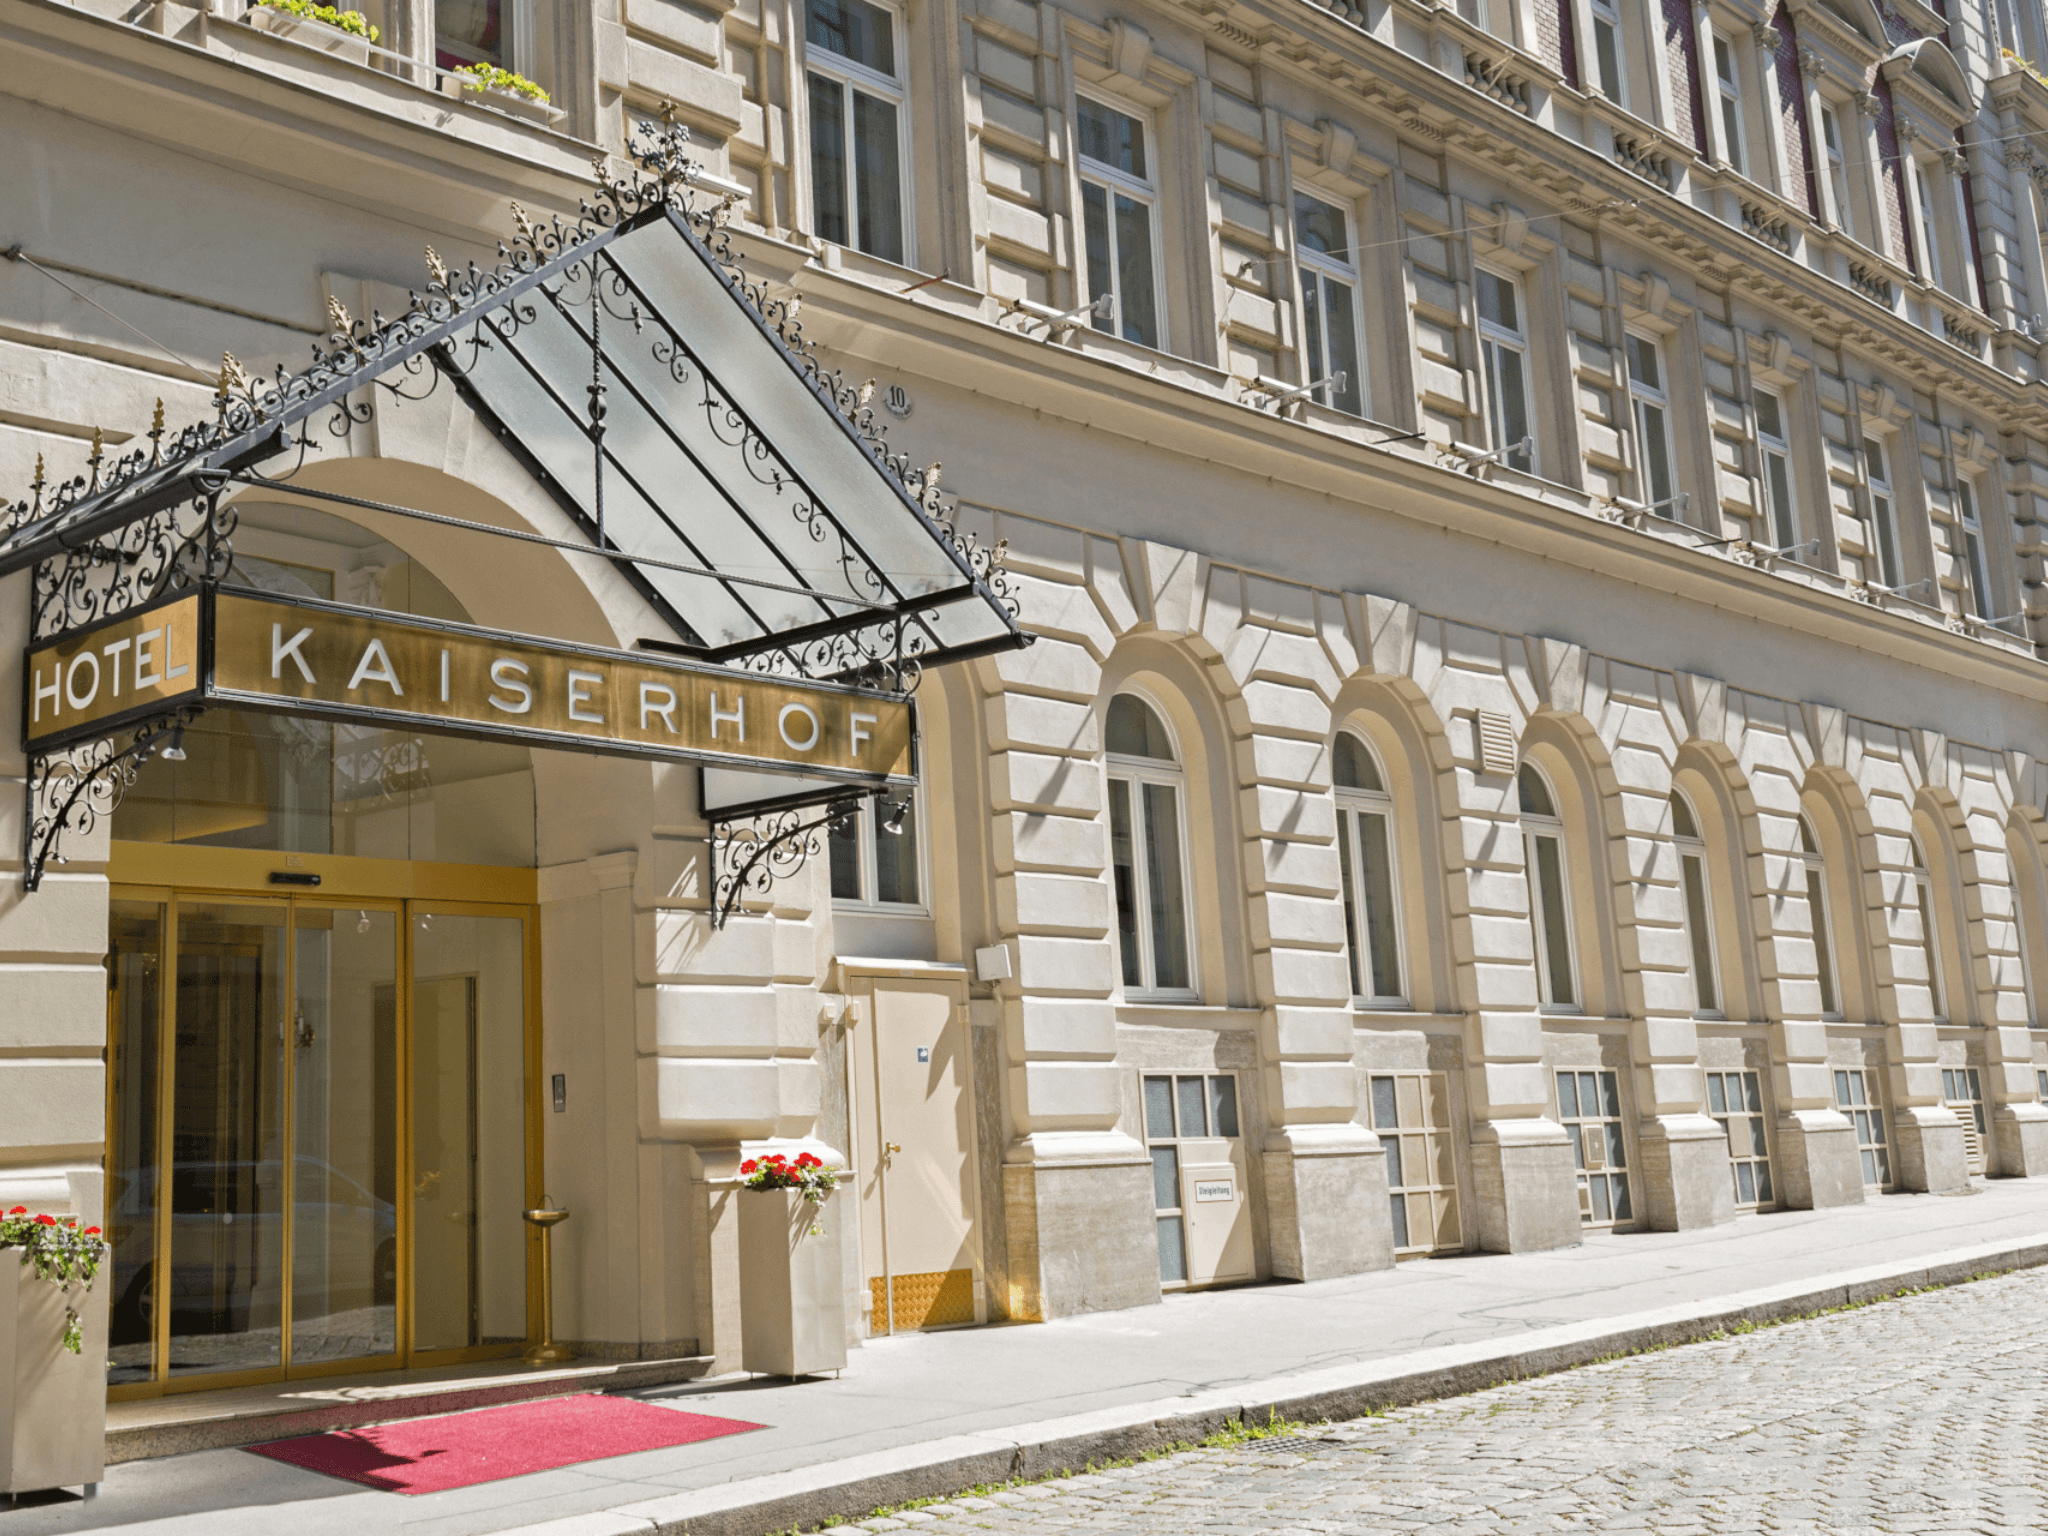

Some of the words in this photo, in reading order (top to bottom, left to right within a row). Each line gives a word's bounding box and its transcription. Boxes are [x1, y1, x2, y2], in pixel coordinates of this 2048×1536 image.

[890, 386, 905, 408] 10
[34, 623, 189, 722] HOTEL
[271, 623, 878, 757] KAISERHOF
